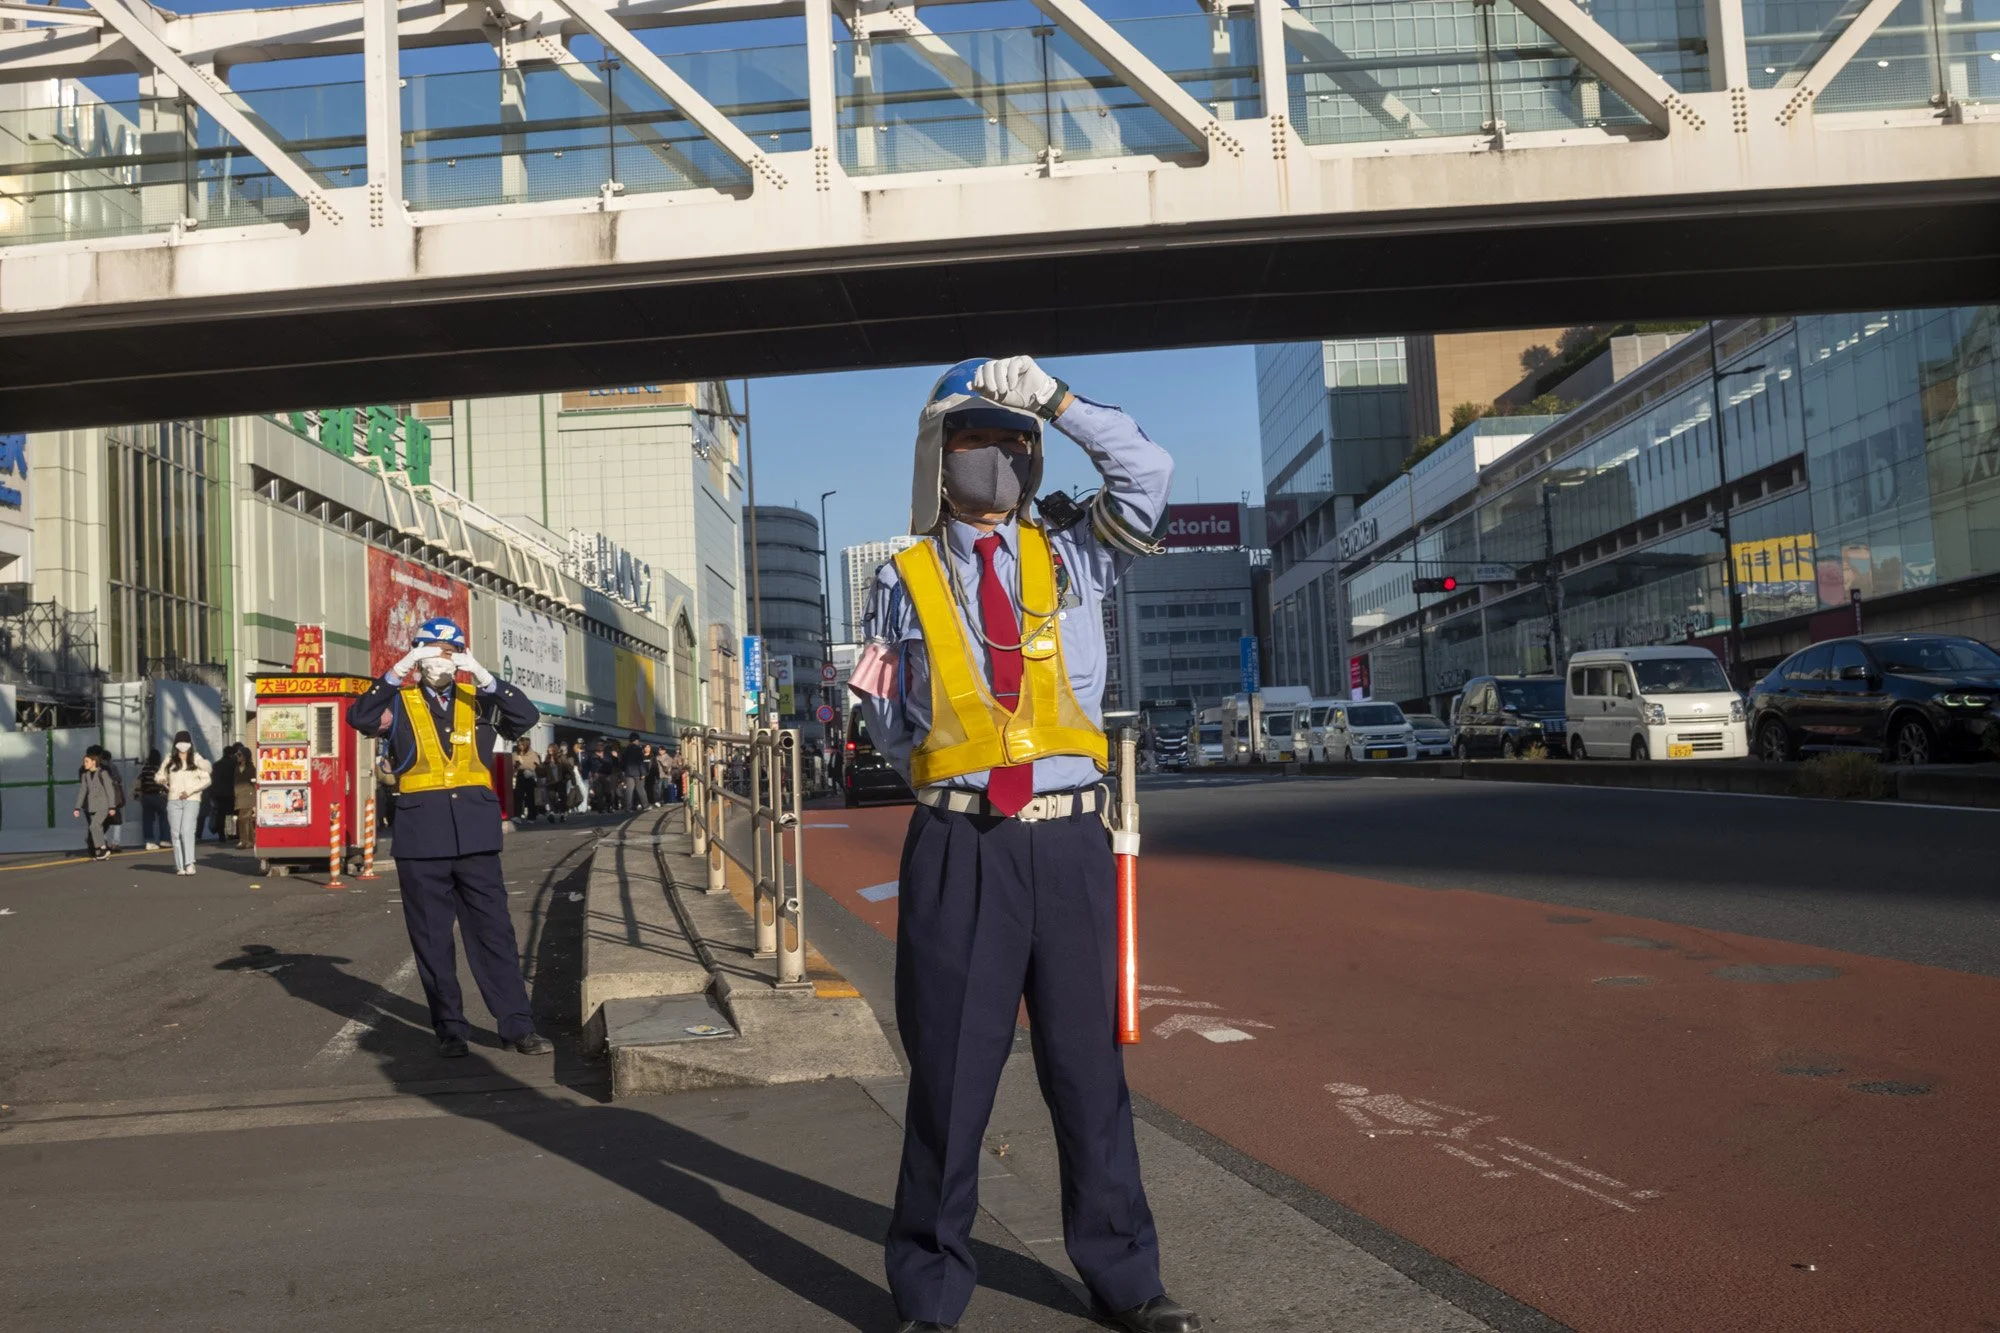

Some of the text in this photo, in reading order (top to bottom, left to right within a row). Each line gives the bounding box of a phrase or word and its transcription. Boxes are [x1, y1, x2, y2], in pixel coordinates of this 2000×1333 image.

[261, 679, 340, 693] 大当りの名所
